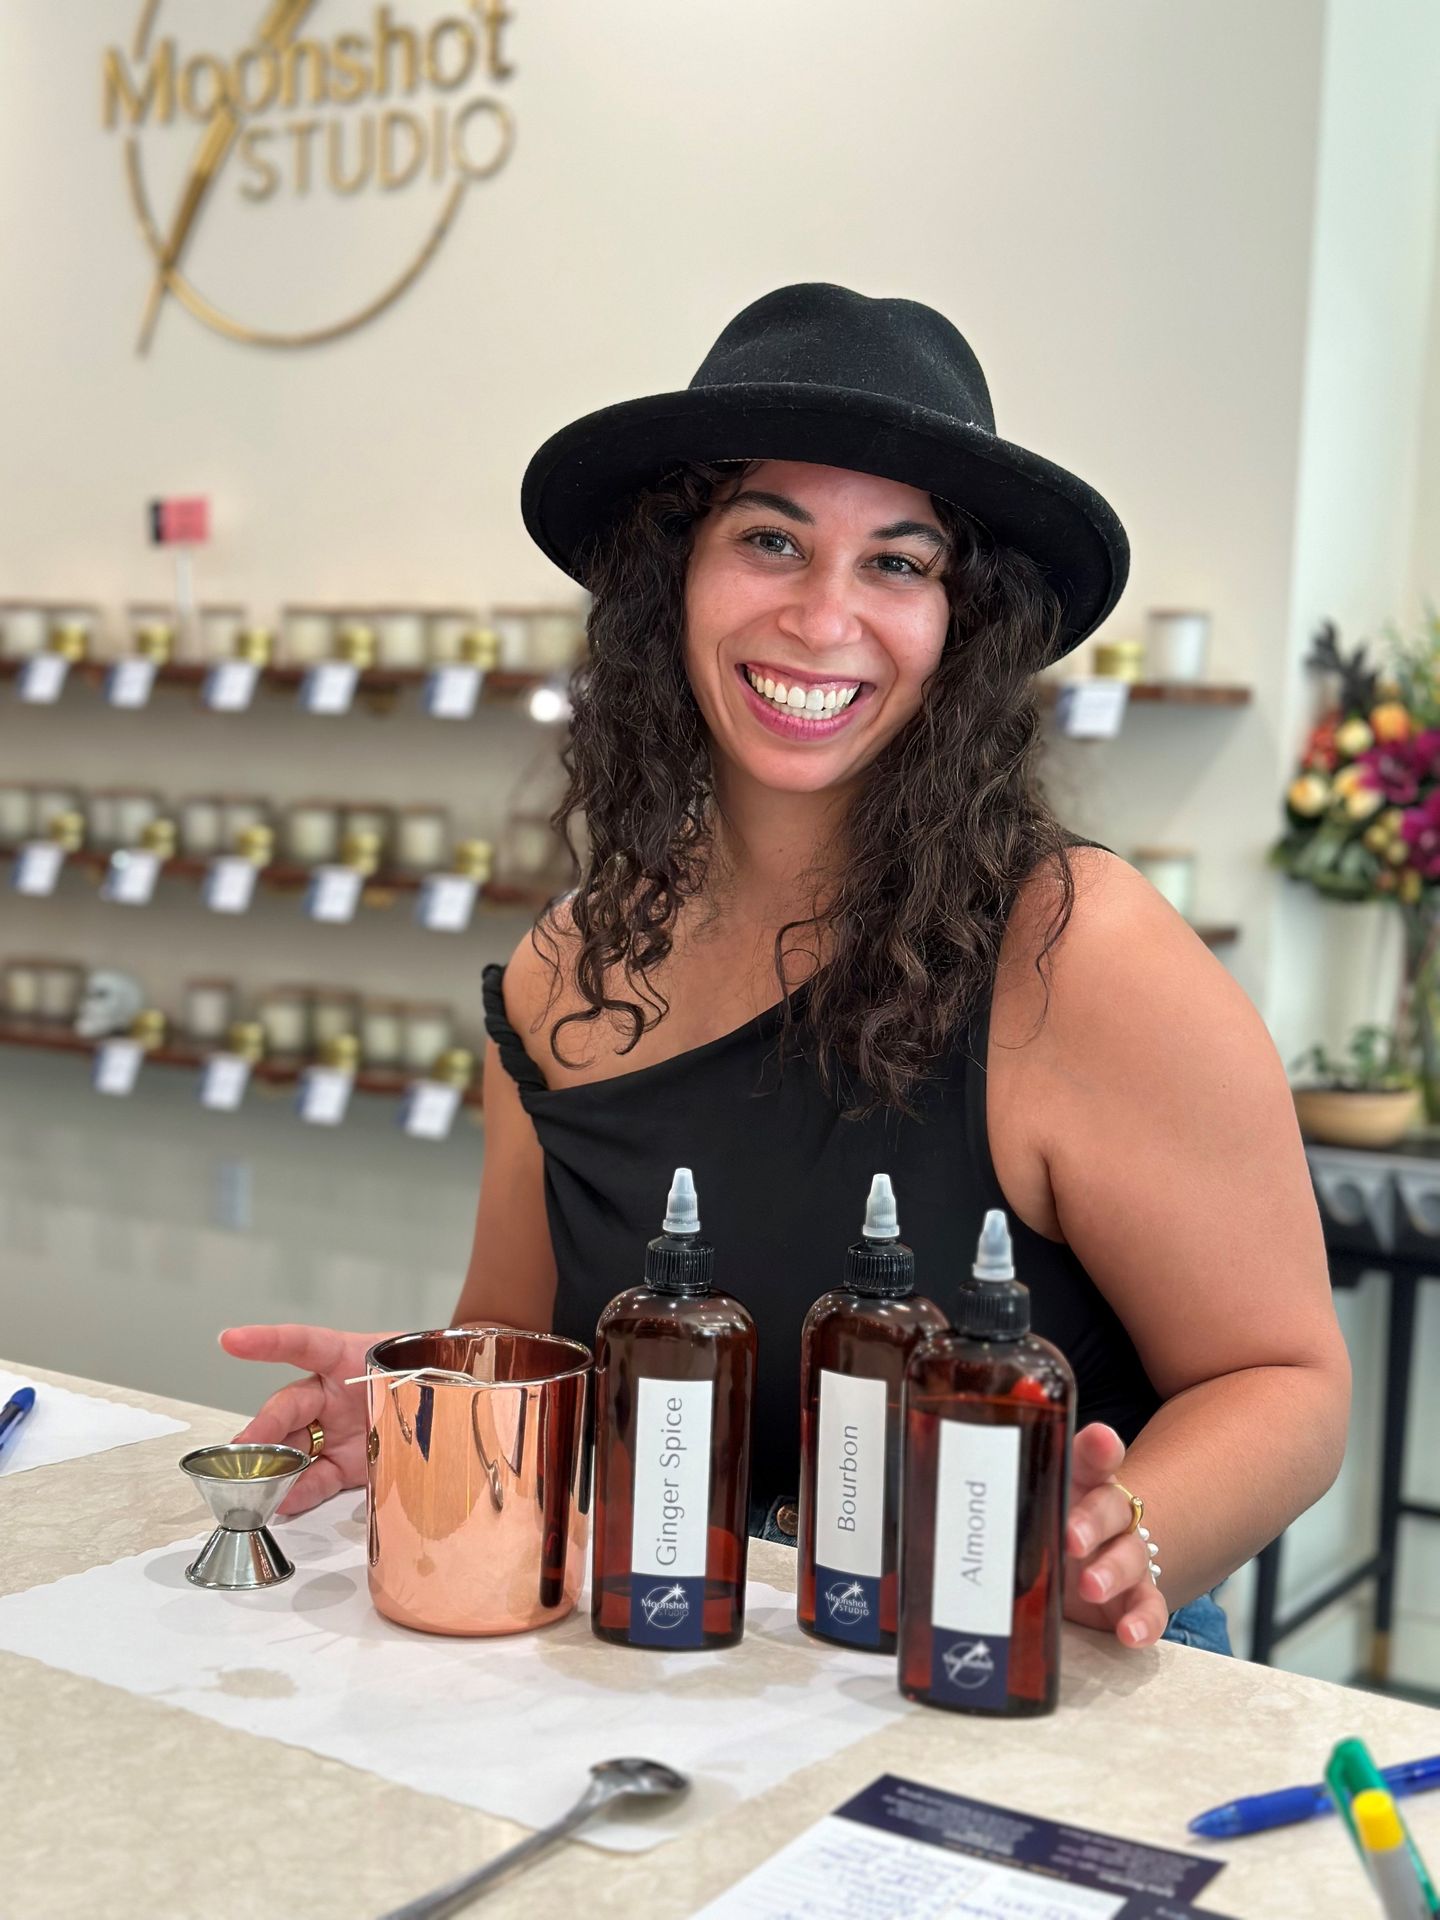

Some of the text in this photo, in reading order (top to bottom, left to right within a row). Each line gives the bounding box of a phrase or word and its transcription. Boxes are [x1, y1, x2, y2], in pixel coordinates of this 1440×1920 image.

[102, 1, 514, 130] Moonshot
[239, 97, 516, 200] STUDIO
[656, 1397, 687, 1566] Ginger Spice
[837, 1425, 859, 1533] Bourbon
[960, 1480, 988, 1587] Almond
[641, 1598, 690, 1610] Moonshot
[825, 1591, 868, 1609] Moonshot
[839, 1604, 870, 1616] STUDIO
